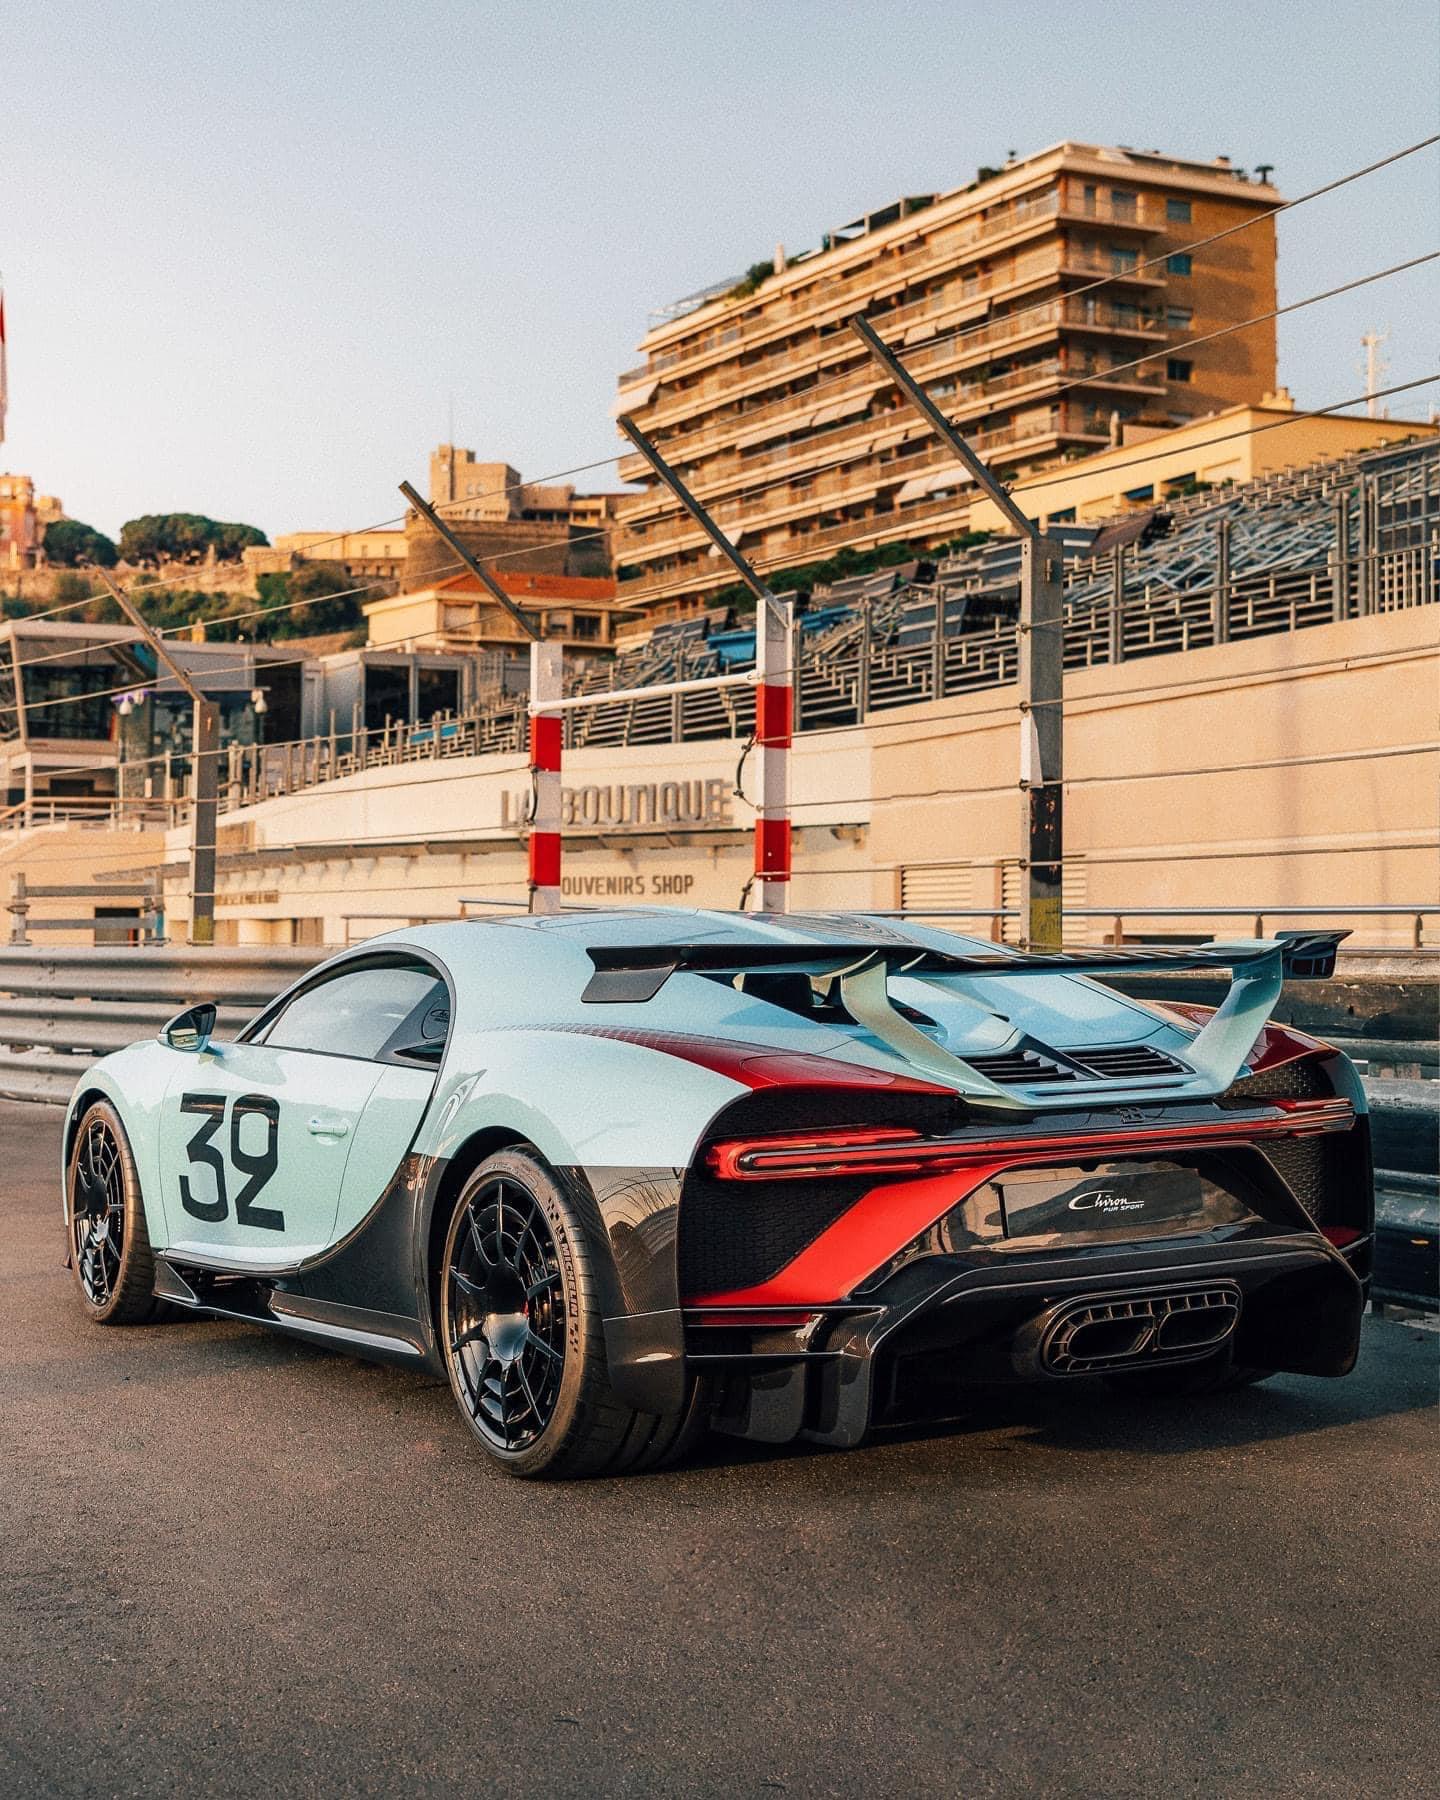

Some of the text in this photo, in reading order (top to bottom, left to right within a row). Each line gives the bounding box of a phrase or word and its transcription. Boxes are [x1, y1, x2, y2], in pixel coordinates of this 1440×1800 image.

[561, 778, 734, 827] BOUTIQUE
[561, 875, 694, 896] OUVENIRS SHOP
[179, 1092, 285, 1232] 32
[1068, 1190, 1145, 1210] Chiron
[1120, 1203, 1145, 1211] SPORT
[560, 1242, 579, 1318] MICHELIN
